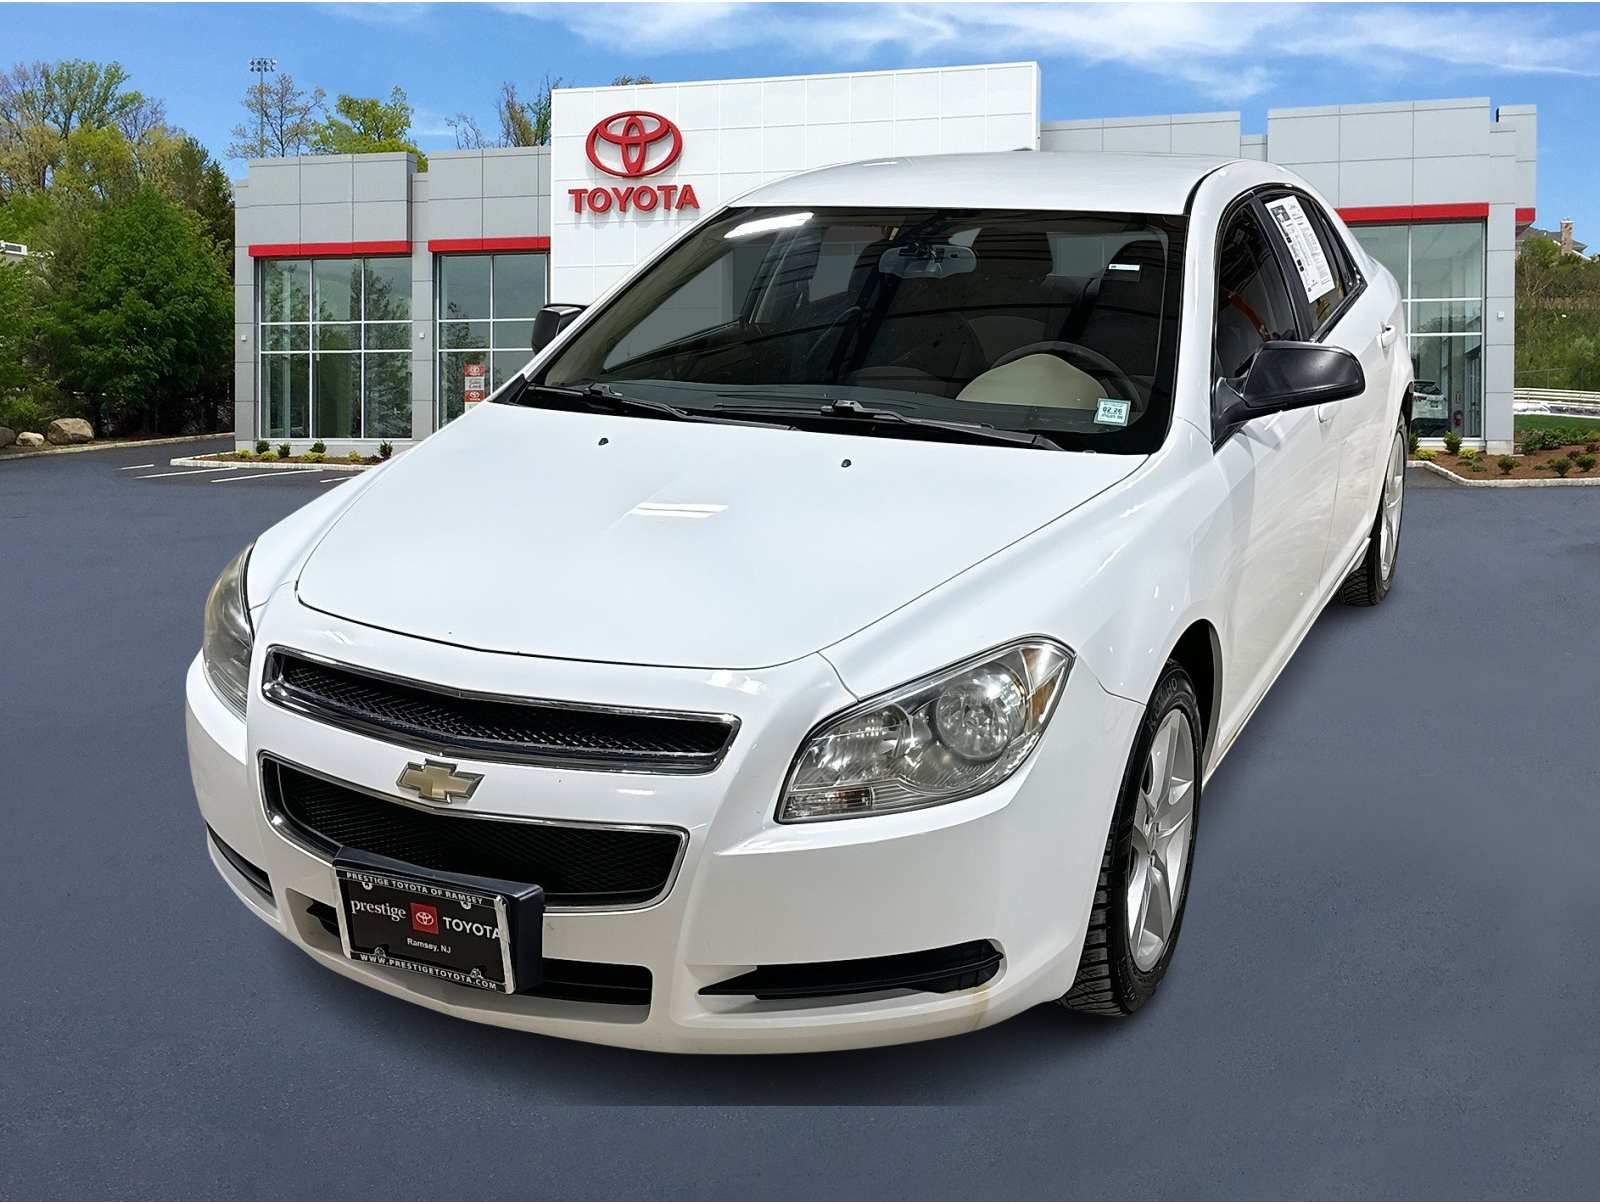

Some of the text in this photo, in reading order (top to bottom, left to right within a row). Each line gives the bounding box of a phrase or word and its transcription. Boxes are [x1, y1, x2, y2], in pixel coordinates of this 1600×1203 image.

[568, 184, 700, 213] TOYOTA
[346, 872, 483, 905] PRESTIGE TOYOTA OF RAMSEY
[350, 900, 501, 939] prestige TOYOTA
[407, 938, 452, 954] Ramsey, NJ
[360, 953, 497, 991] WWW.PRESTIGETOYOTA.COM
